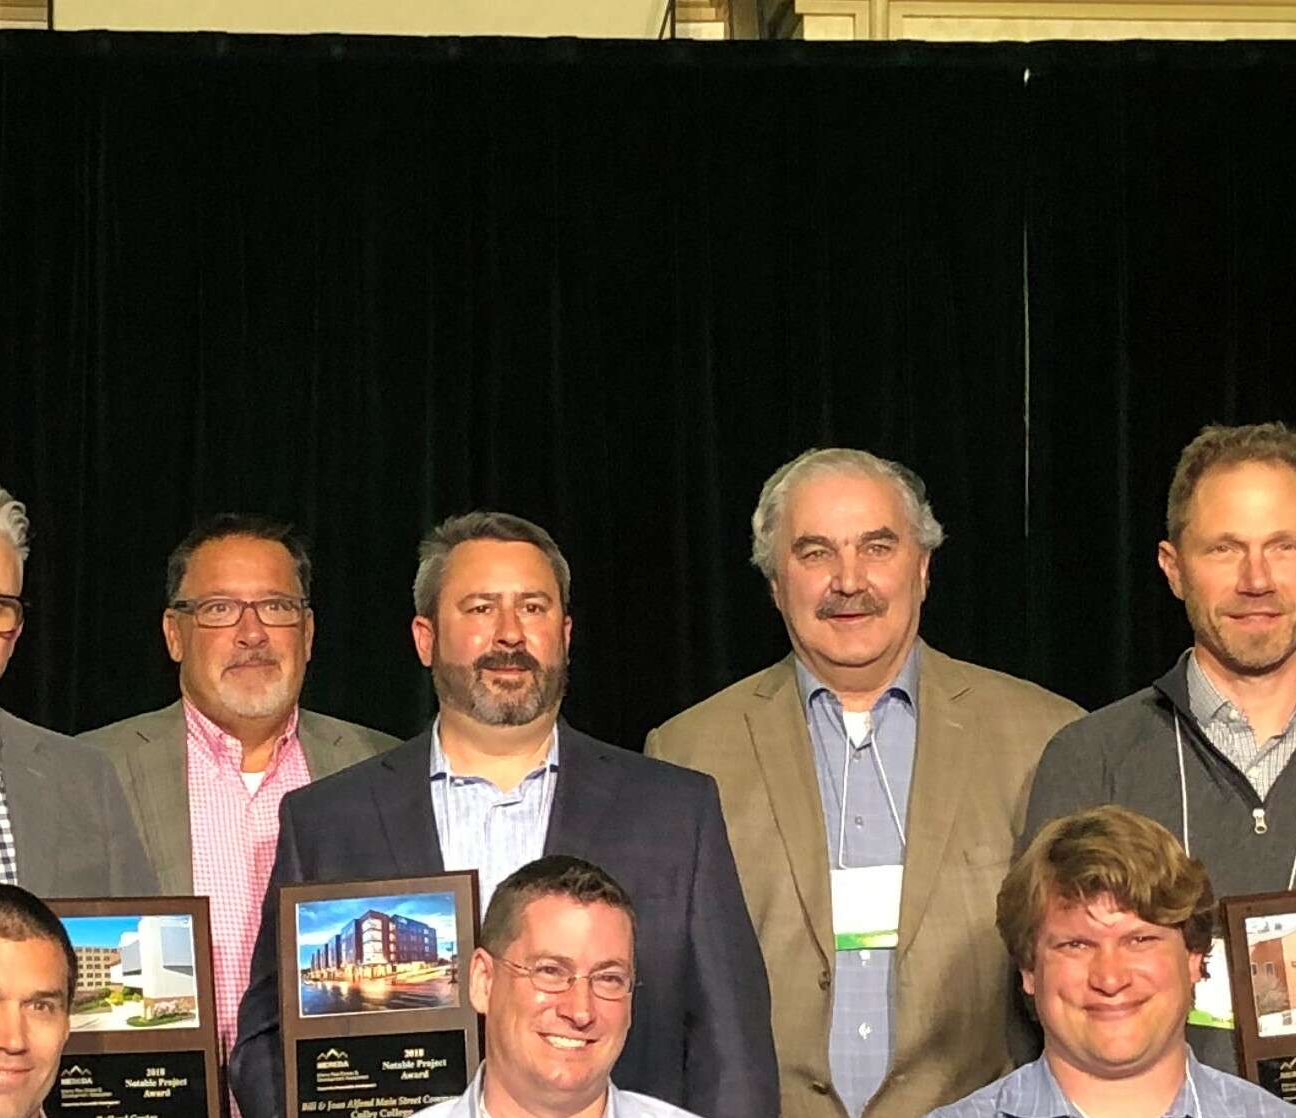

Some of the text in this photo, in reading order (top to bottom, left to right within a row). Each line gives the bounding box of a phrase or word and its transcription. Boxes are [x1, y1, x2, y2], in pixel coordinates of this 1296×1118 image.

[404, 1048, 425, 1058] 2018
[382, 1058, 447, 1071] Notable Project
[146, 1068, 166, 1077] 2018
[401, 1069, 429, 1081] Award
[125, 1077, 188, 1088] Notable Project
[143, 1088, 171, 1099] Award
[302, 1101, 317, 1112] Bill
[318, 1101, 327, 1111] &
[376, 1096, 397, 1107] Main
[398, 1096, 422, 1106] Street
